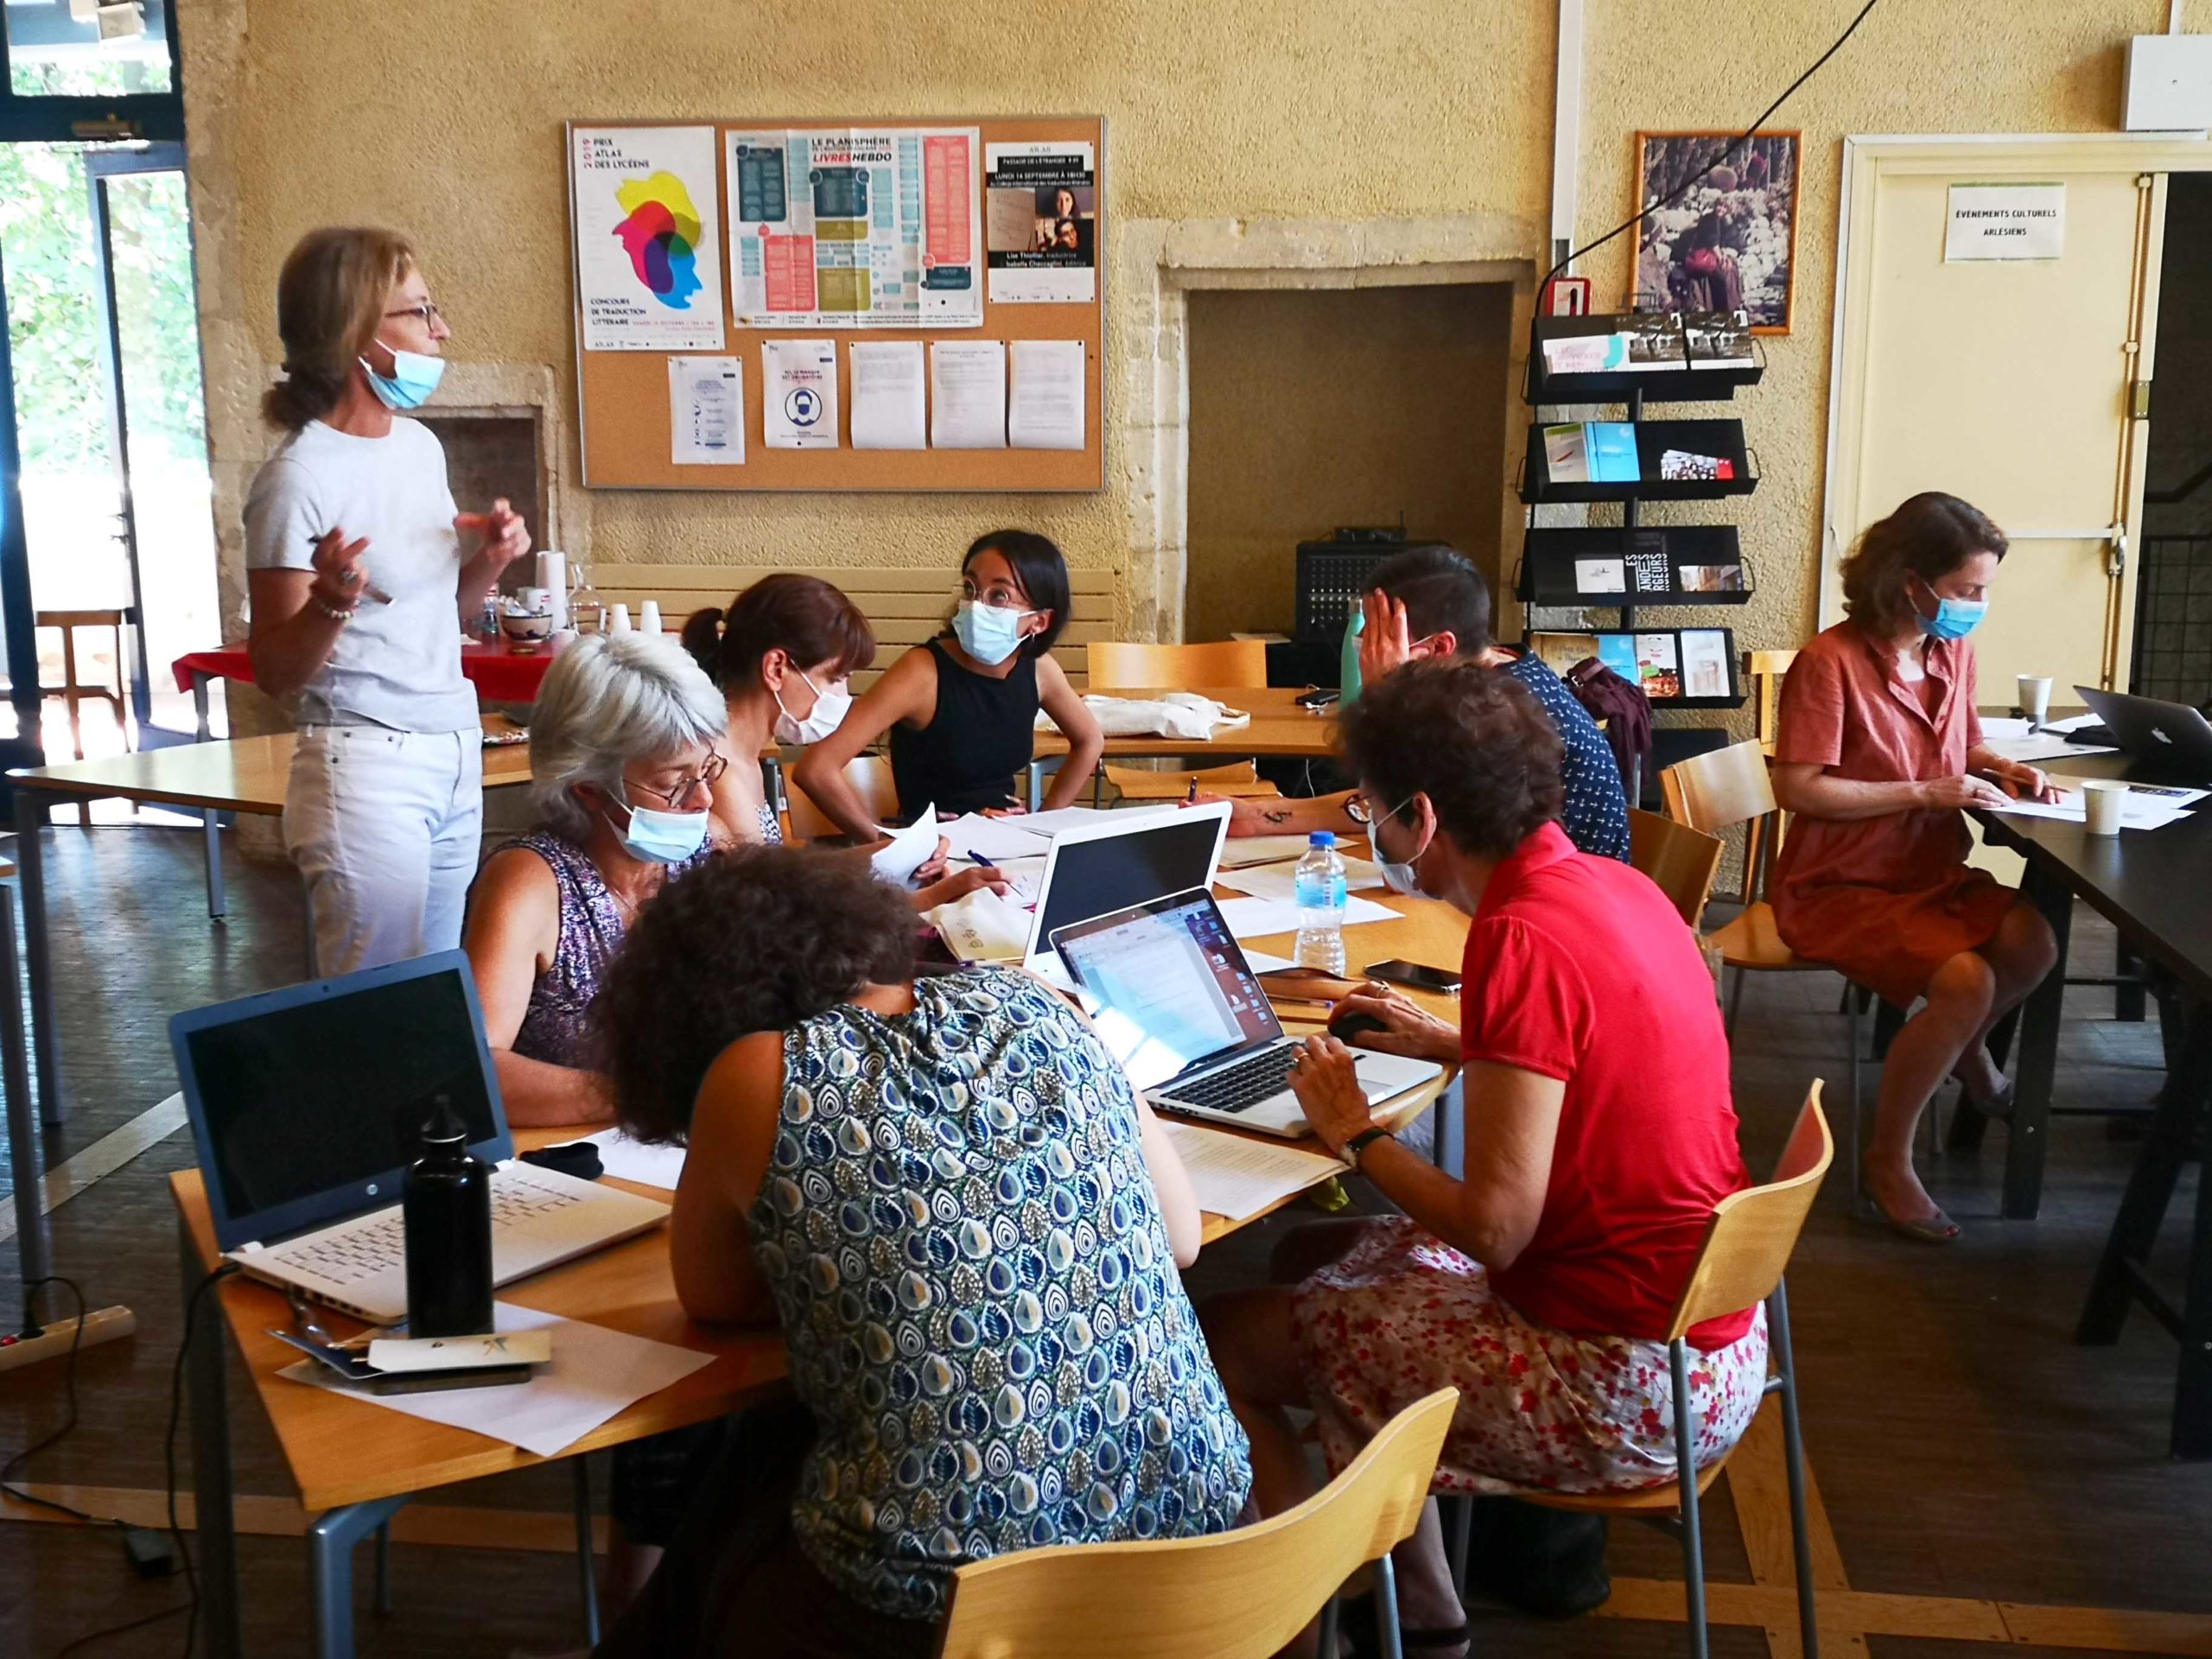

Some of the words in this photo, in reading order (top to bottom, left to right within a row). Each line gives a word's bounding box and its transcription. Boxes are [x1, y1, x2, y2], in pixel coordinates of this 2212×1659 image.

[593, 137, 613, 146] PRIX
[595, 149, 622, 157] ATLAS
[813, 152, 851, 162] LIVRES
[852, 152, 892, 162] HEBDO
[594, 161, 610, 169] DES
[2012, 208, 2057, 218] CULTURELS
[601, 308, 647, 316] TRADUCTION
[1637, 553, 1652, 592] ANDES
